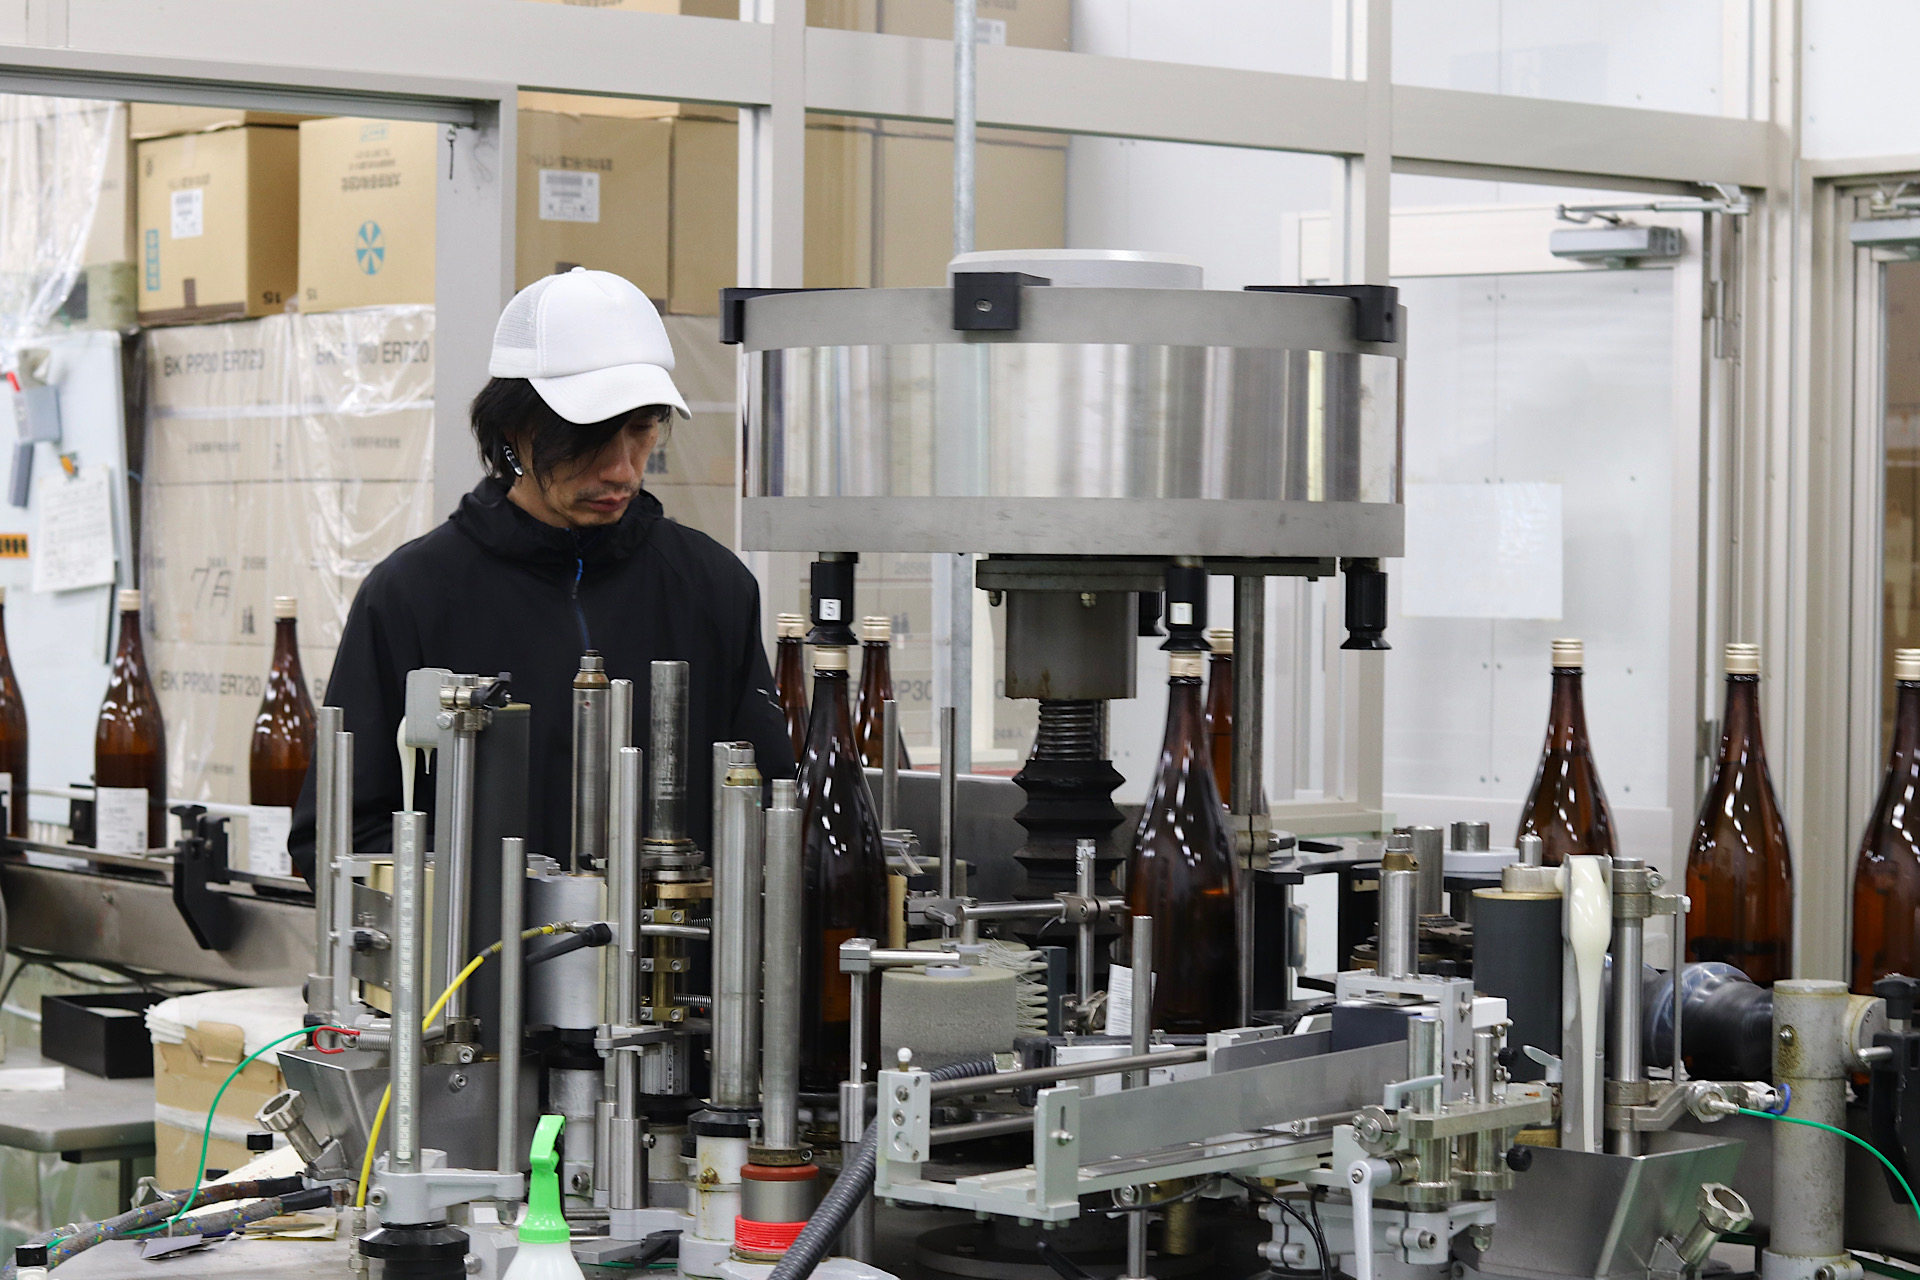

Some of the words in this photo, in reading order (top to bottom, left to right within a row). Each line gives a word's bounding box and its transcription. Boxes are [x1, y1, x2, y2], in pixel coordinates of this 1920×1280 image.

[163, 355, 183, 377] BK
[187, 351, 218, 375] PP30
[223, 348, 265, 373] ER720
[825, 601, 836, 617] 5
[160, 670, 181, 692] BK
[183, 671, 214, 695] PP30
[219, 673, 261, 697] ER720
